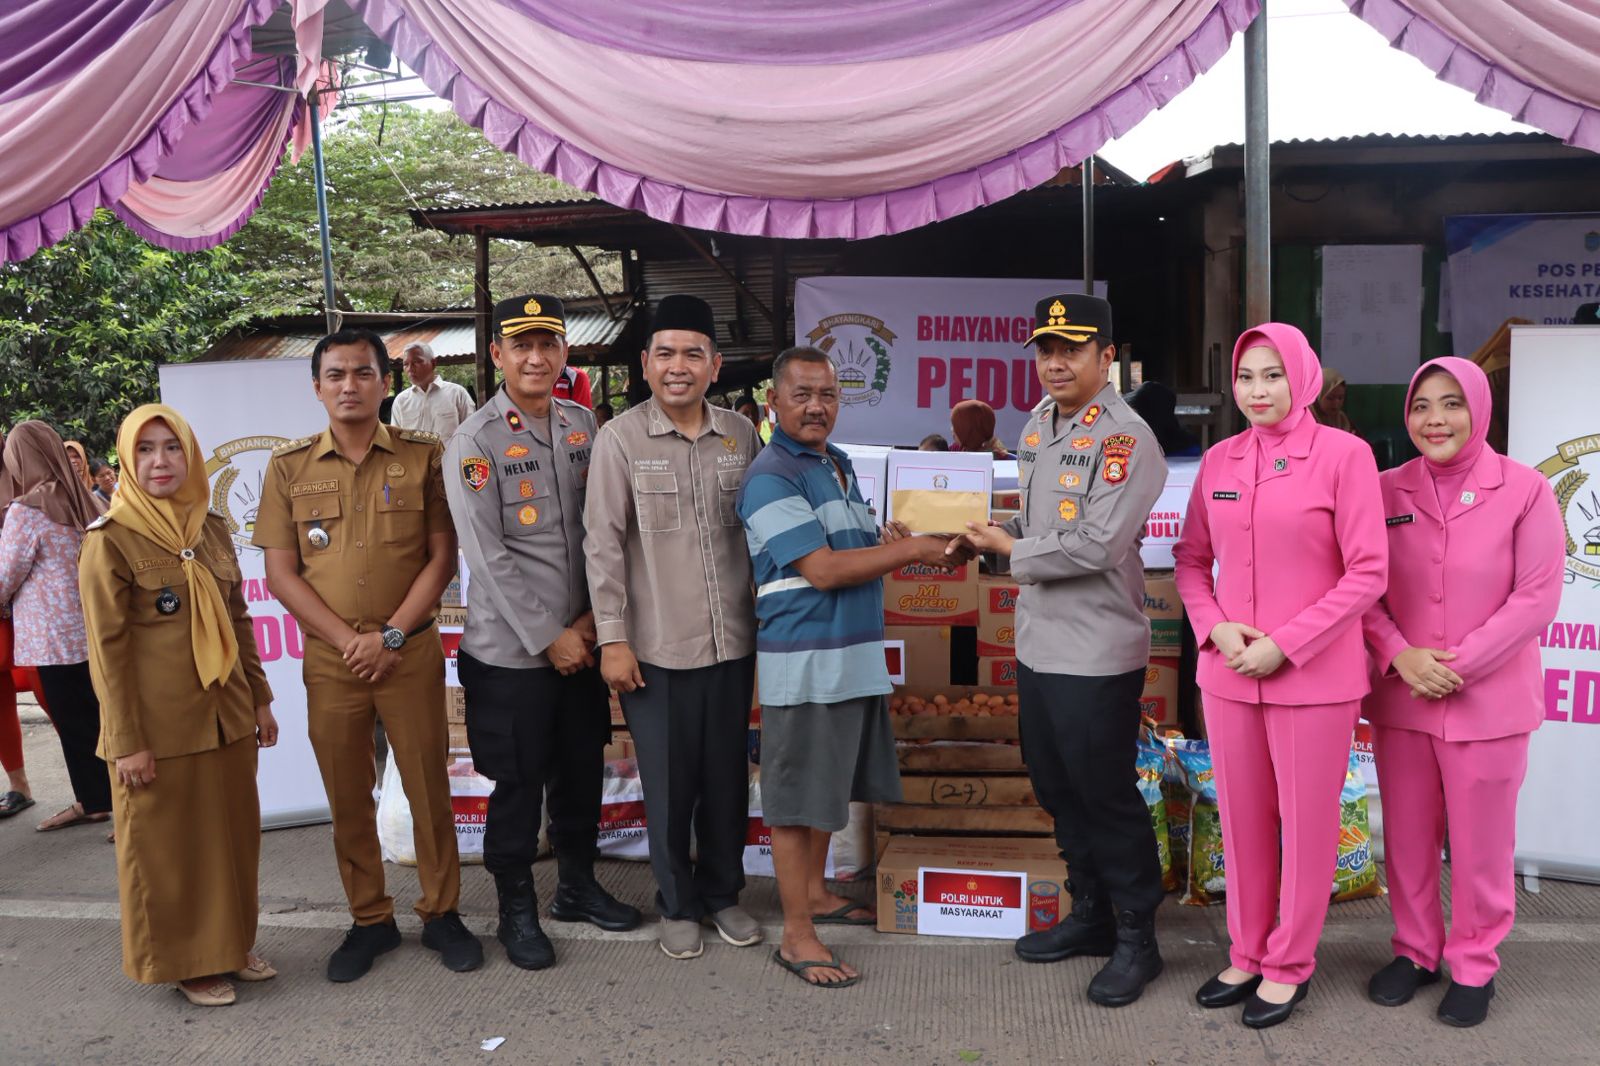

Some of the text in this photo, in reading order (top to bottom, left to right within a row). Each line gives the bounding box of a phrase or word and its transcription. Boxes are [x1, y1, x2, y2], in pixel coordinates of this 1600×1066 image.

[1538, 263, 1600, 277] POS PE
[917, 357, 1044, 412] PEDU
[569, 448, 591, 463] POL
[717, 454, 745, 463] BAZNA
[1060, 454, 1091, 467] POLRI
[504, 460, 541, 476] HELMI
[1150, 512, 1180, 520] GKARI
[1566, 558, 1600, 577] KEMAL
[916, 584, 941, 598] Mi
[899, 595, 959, 610] Goreng
[453, 615, 467, 624] AN
[1354, 741, 1373, 751] OLR
[455, 813, 479, 823] POLRI
[614, 818, 642, 828] UNTUK
[1337, 839, 1369, 871] ortel
[896, 898, 918, 914] SAR
[940, 893, 1004, 906] POLRI UNTUK
[940, 907, 1004, 919] MASYARAKAT
